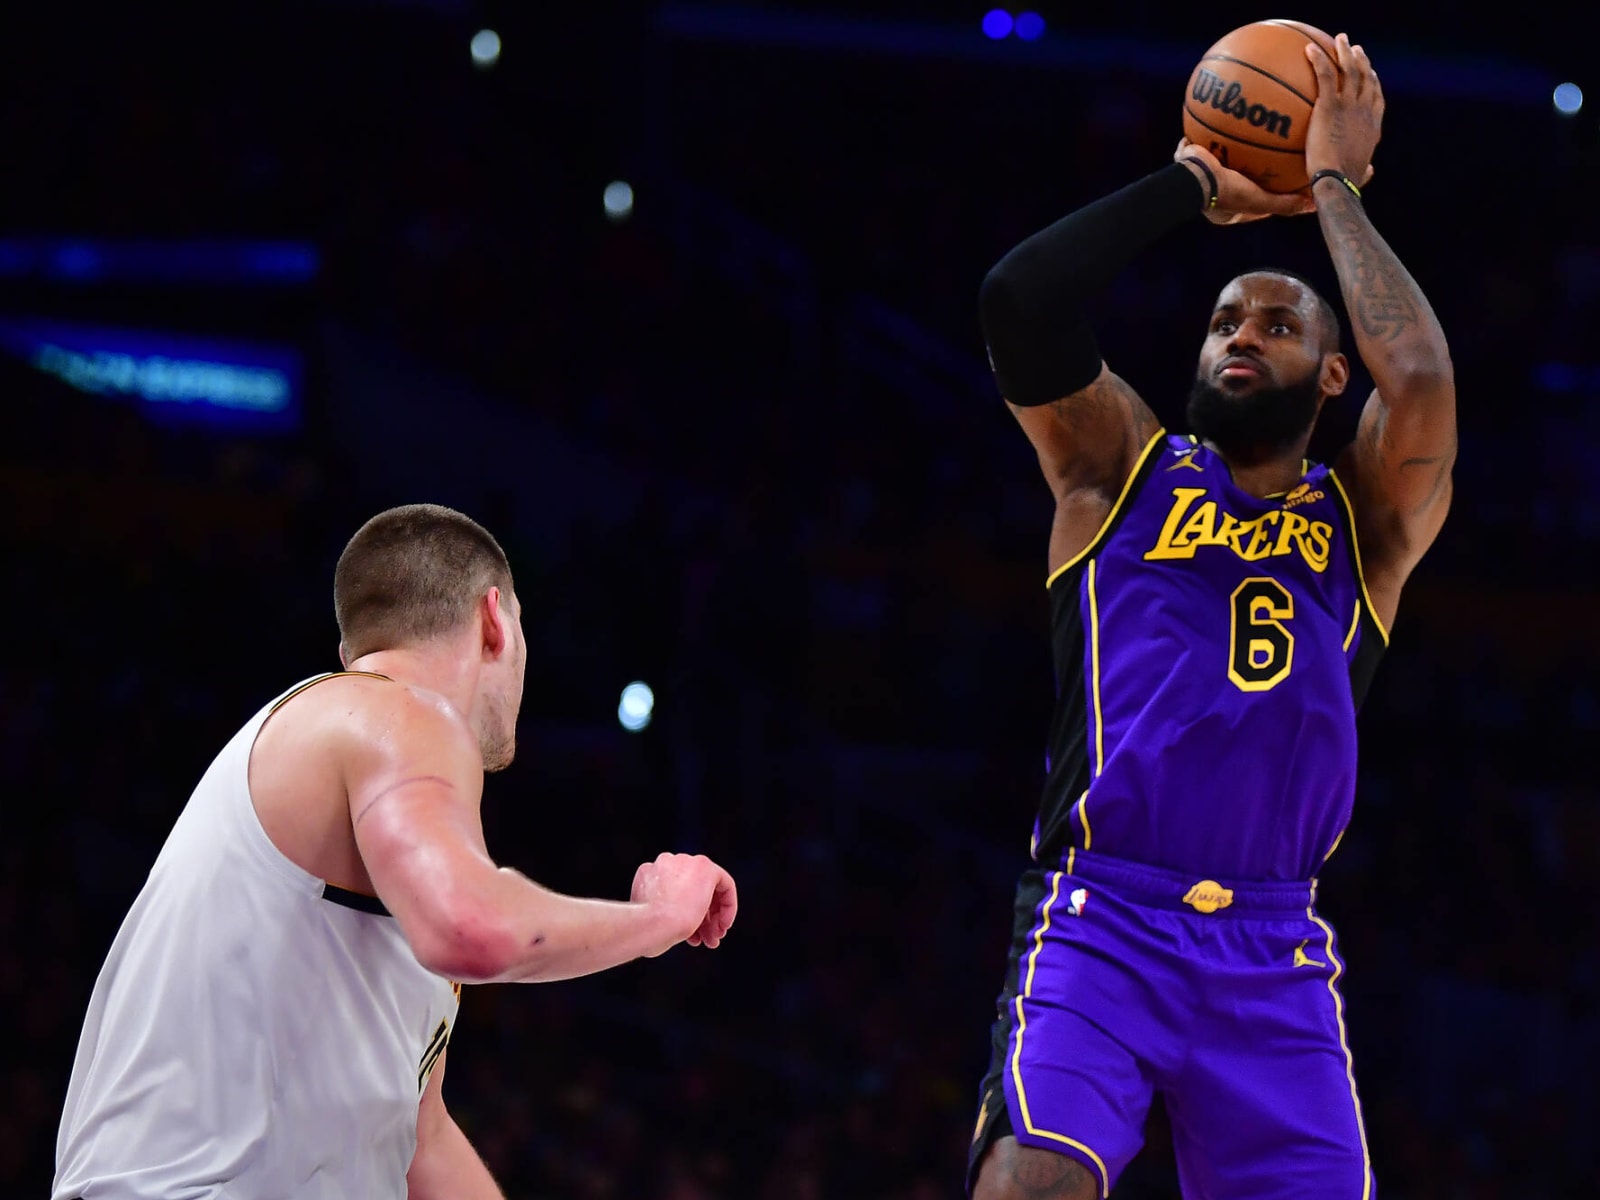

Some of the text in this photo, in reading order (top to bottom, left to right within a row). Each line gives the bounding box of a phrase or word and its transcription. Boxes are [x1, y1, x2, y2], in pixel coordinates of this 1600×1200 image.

[1192, 69, 1292, 139] Wilson
[1143, 487, 1333, 573] LAKERS
[1227, 576, 1295, 692] 6
